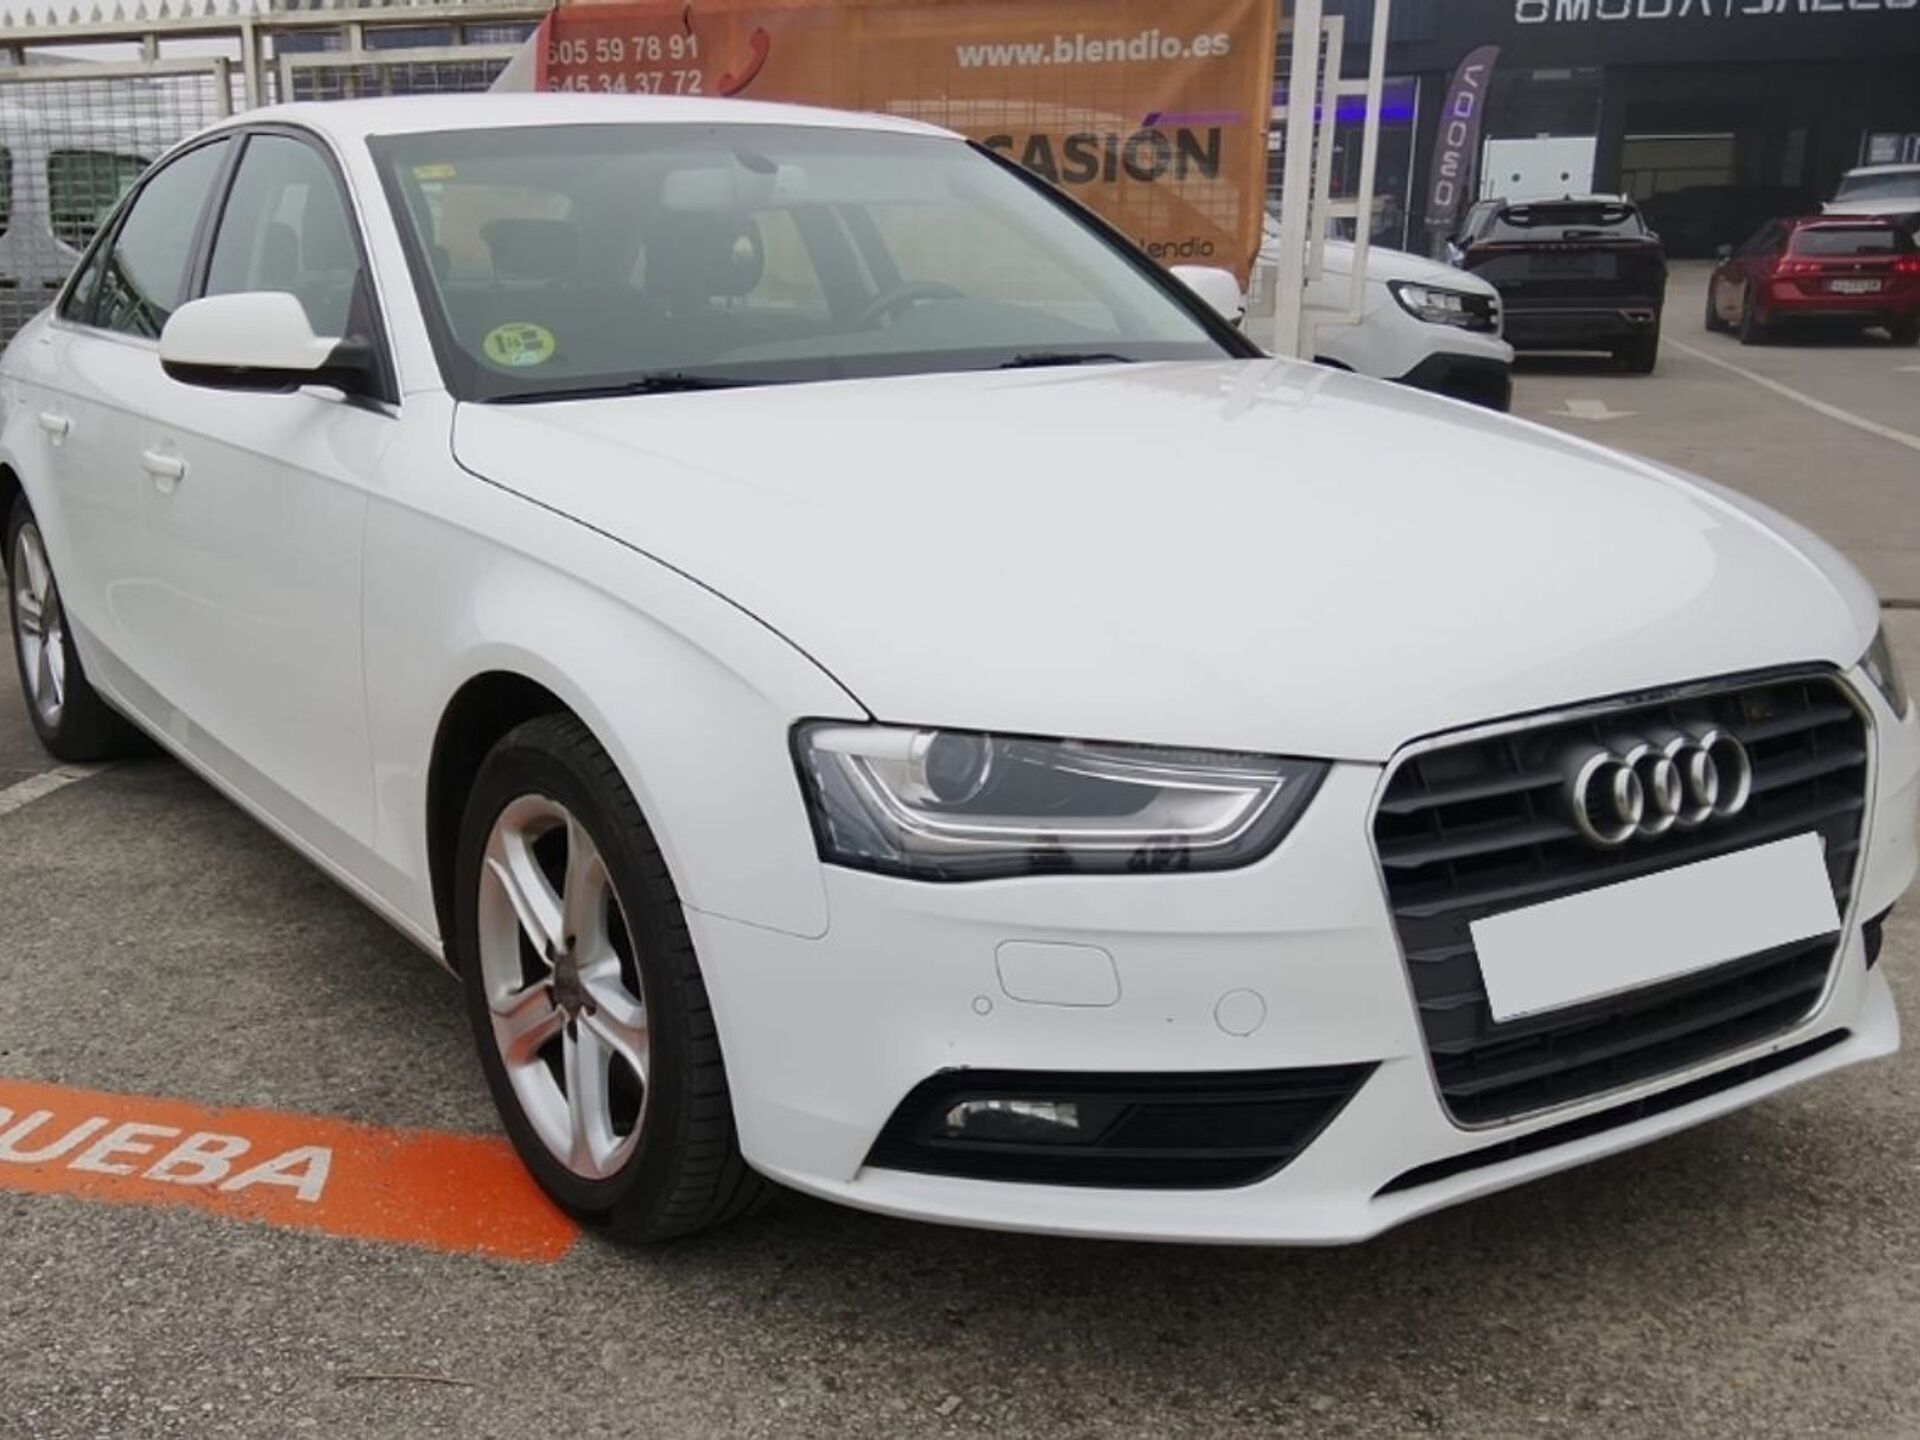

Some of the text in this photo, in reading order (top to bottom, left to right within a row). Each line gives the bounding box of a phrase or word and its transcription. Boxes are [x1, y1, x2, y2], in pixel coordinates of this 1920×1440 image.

[596, 37, 624, 62] 59
[632, 35, 662, 61] 78
[669, 34, 698, 59] 91
[957, 29, 1231, 67] www.blendio.es
[635, 71, 663, 94] 37
[672, 69, 702, 94] 72
[1435, 64, 1484, 206] OMODA
